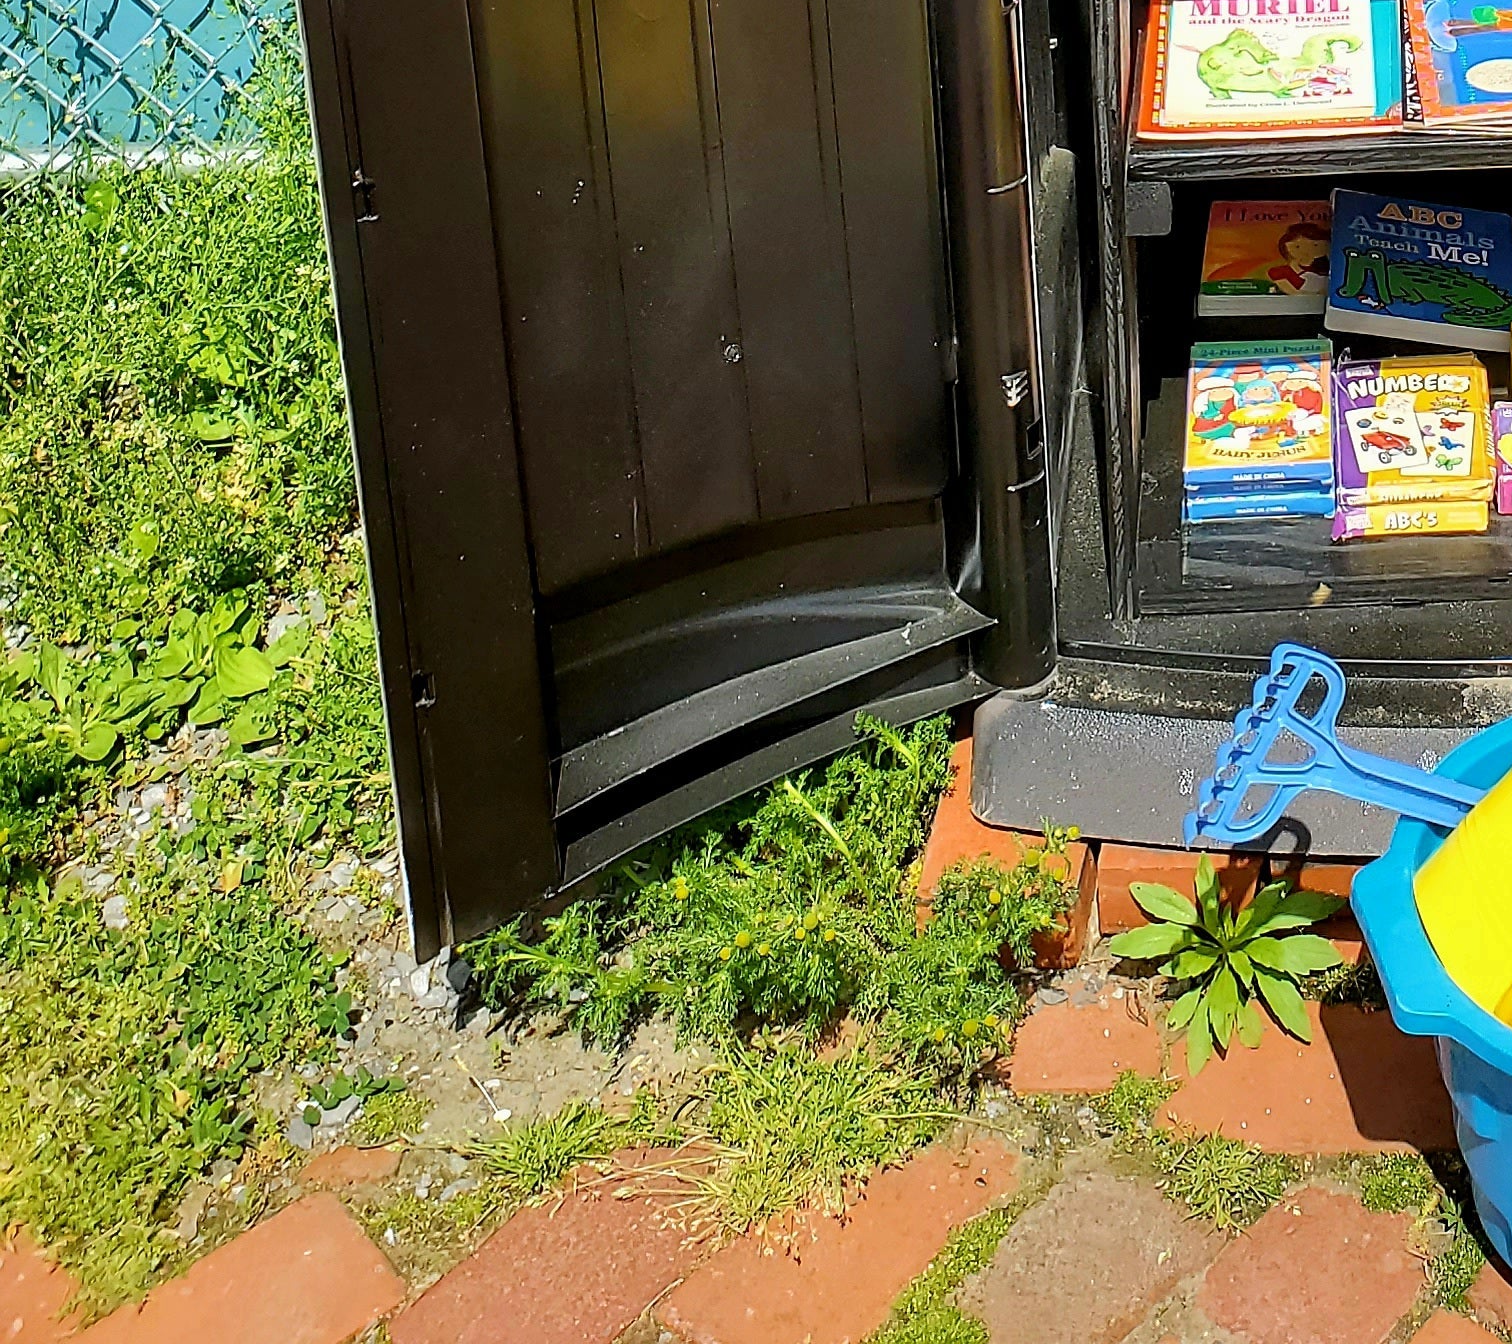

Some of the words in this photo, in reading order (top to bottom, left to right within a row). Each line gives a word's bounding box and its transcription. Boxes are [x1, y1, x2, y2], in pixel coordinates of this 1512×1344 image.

[1378, 202, 1463, 229] ABC
[1349, 216, 1495, 250] Animals
[1354, 234, 1419, 254] Teach
[1427, 243, 1489, 267] Me!
